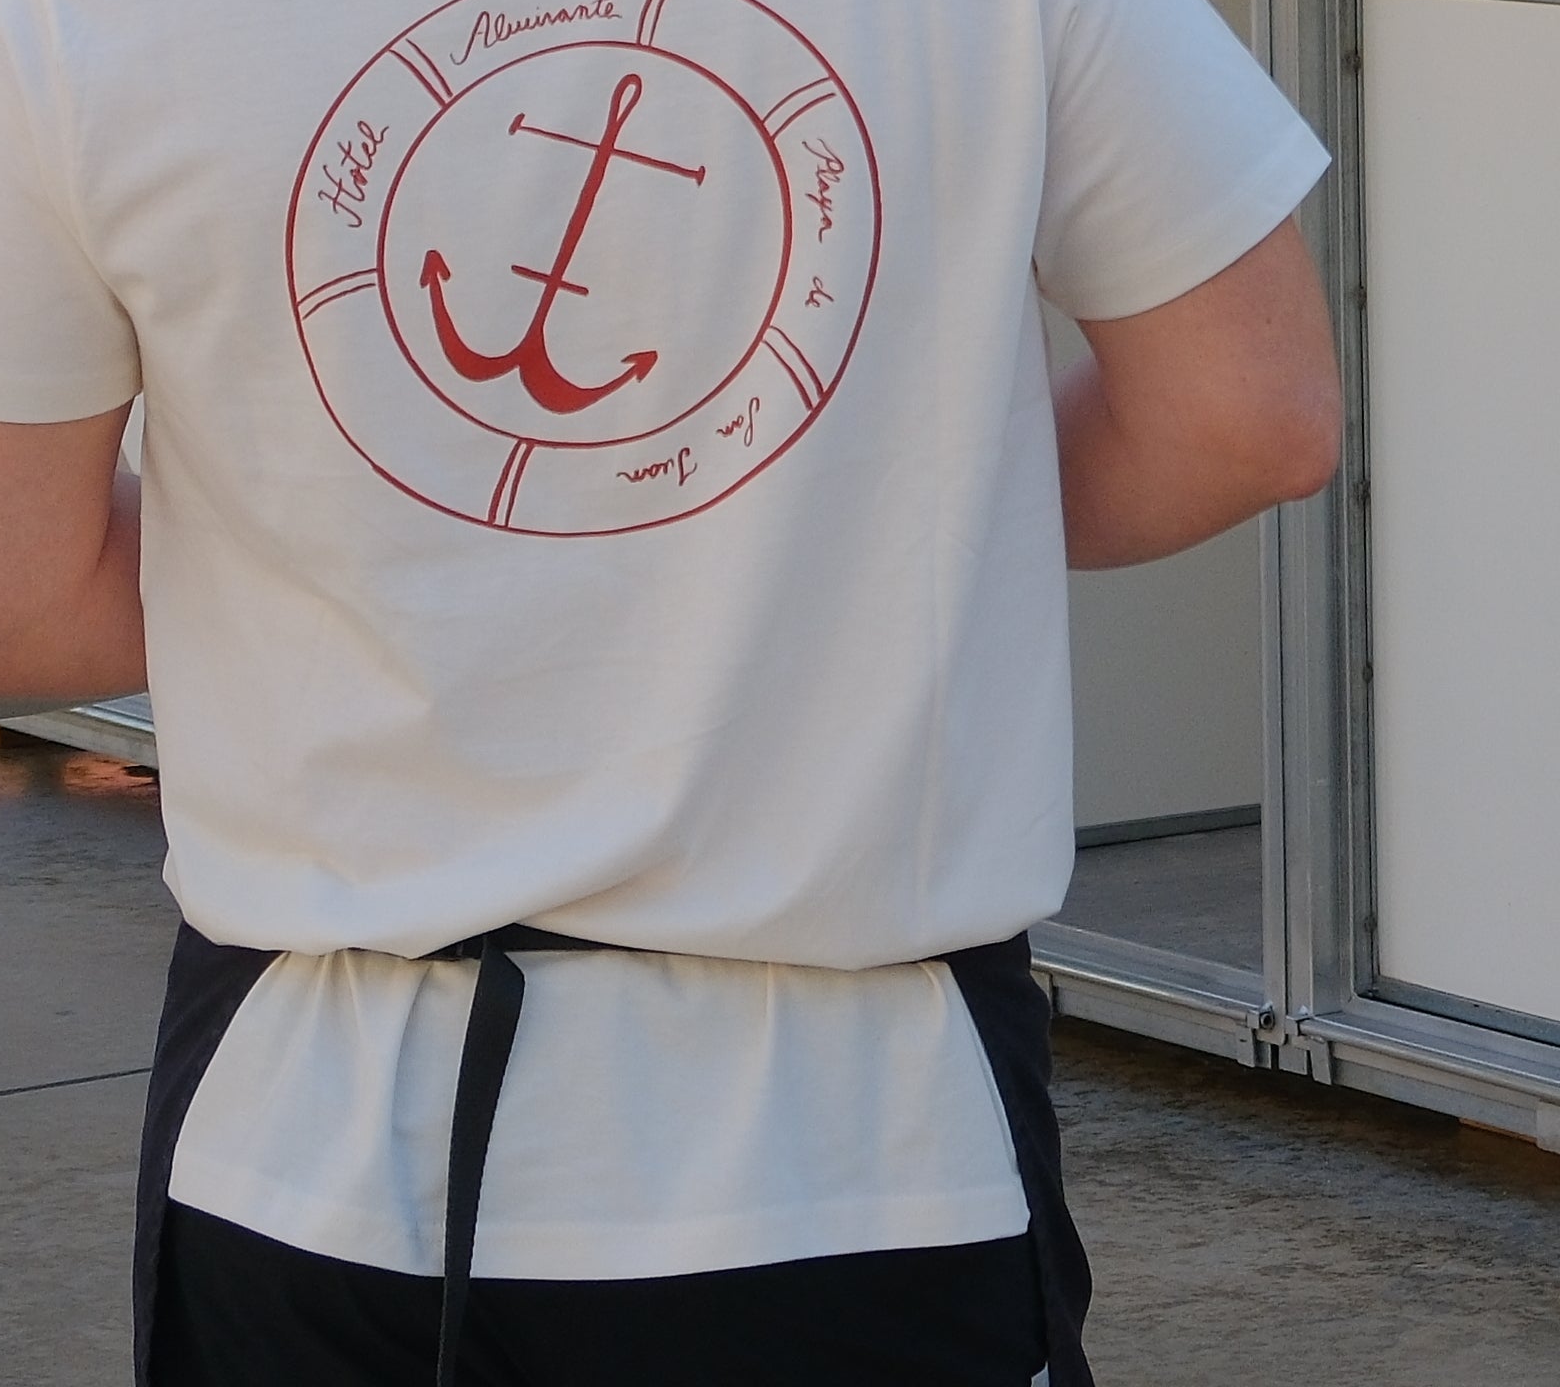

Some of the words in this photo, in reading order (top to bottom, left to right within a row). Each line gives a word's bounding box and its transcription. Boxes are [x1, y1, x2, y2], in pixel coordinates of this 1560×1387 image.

[317, 120, 389, 227] Hotel
[804, 276, 834, 309] de
[616, 447, 698, 486] Juan
